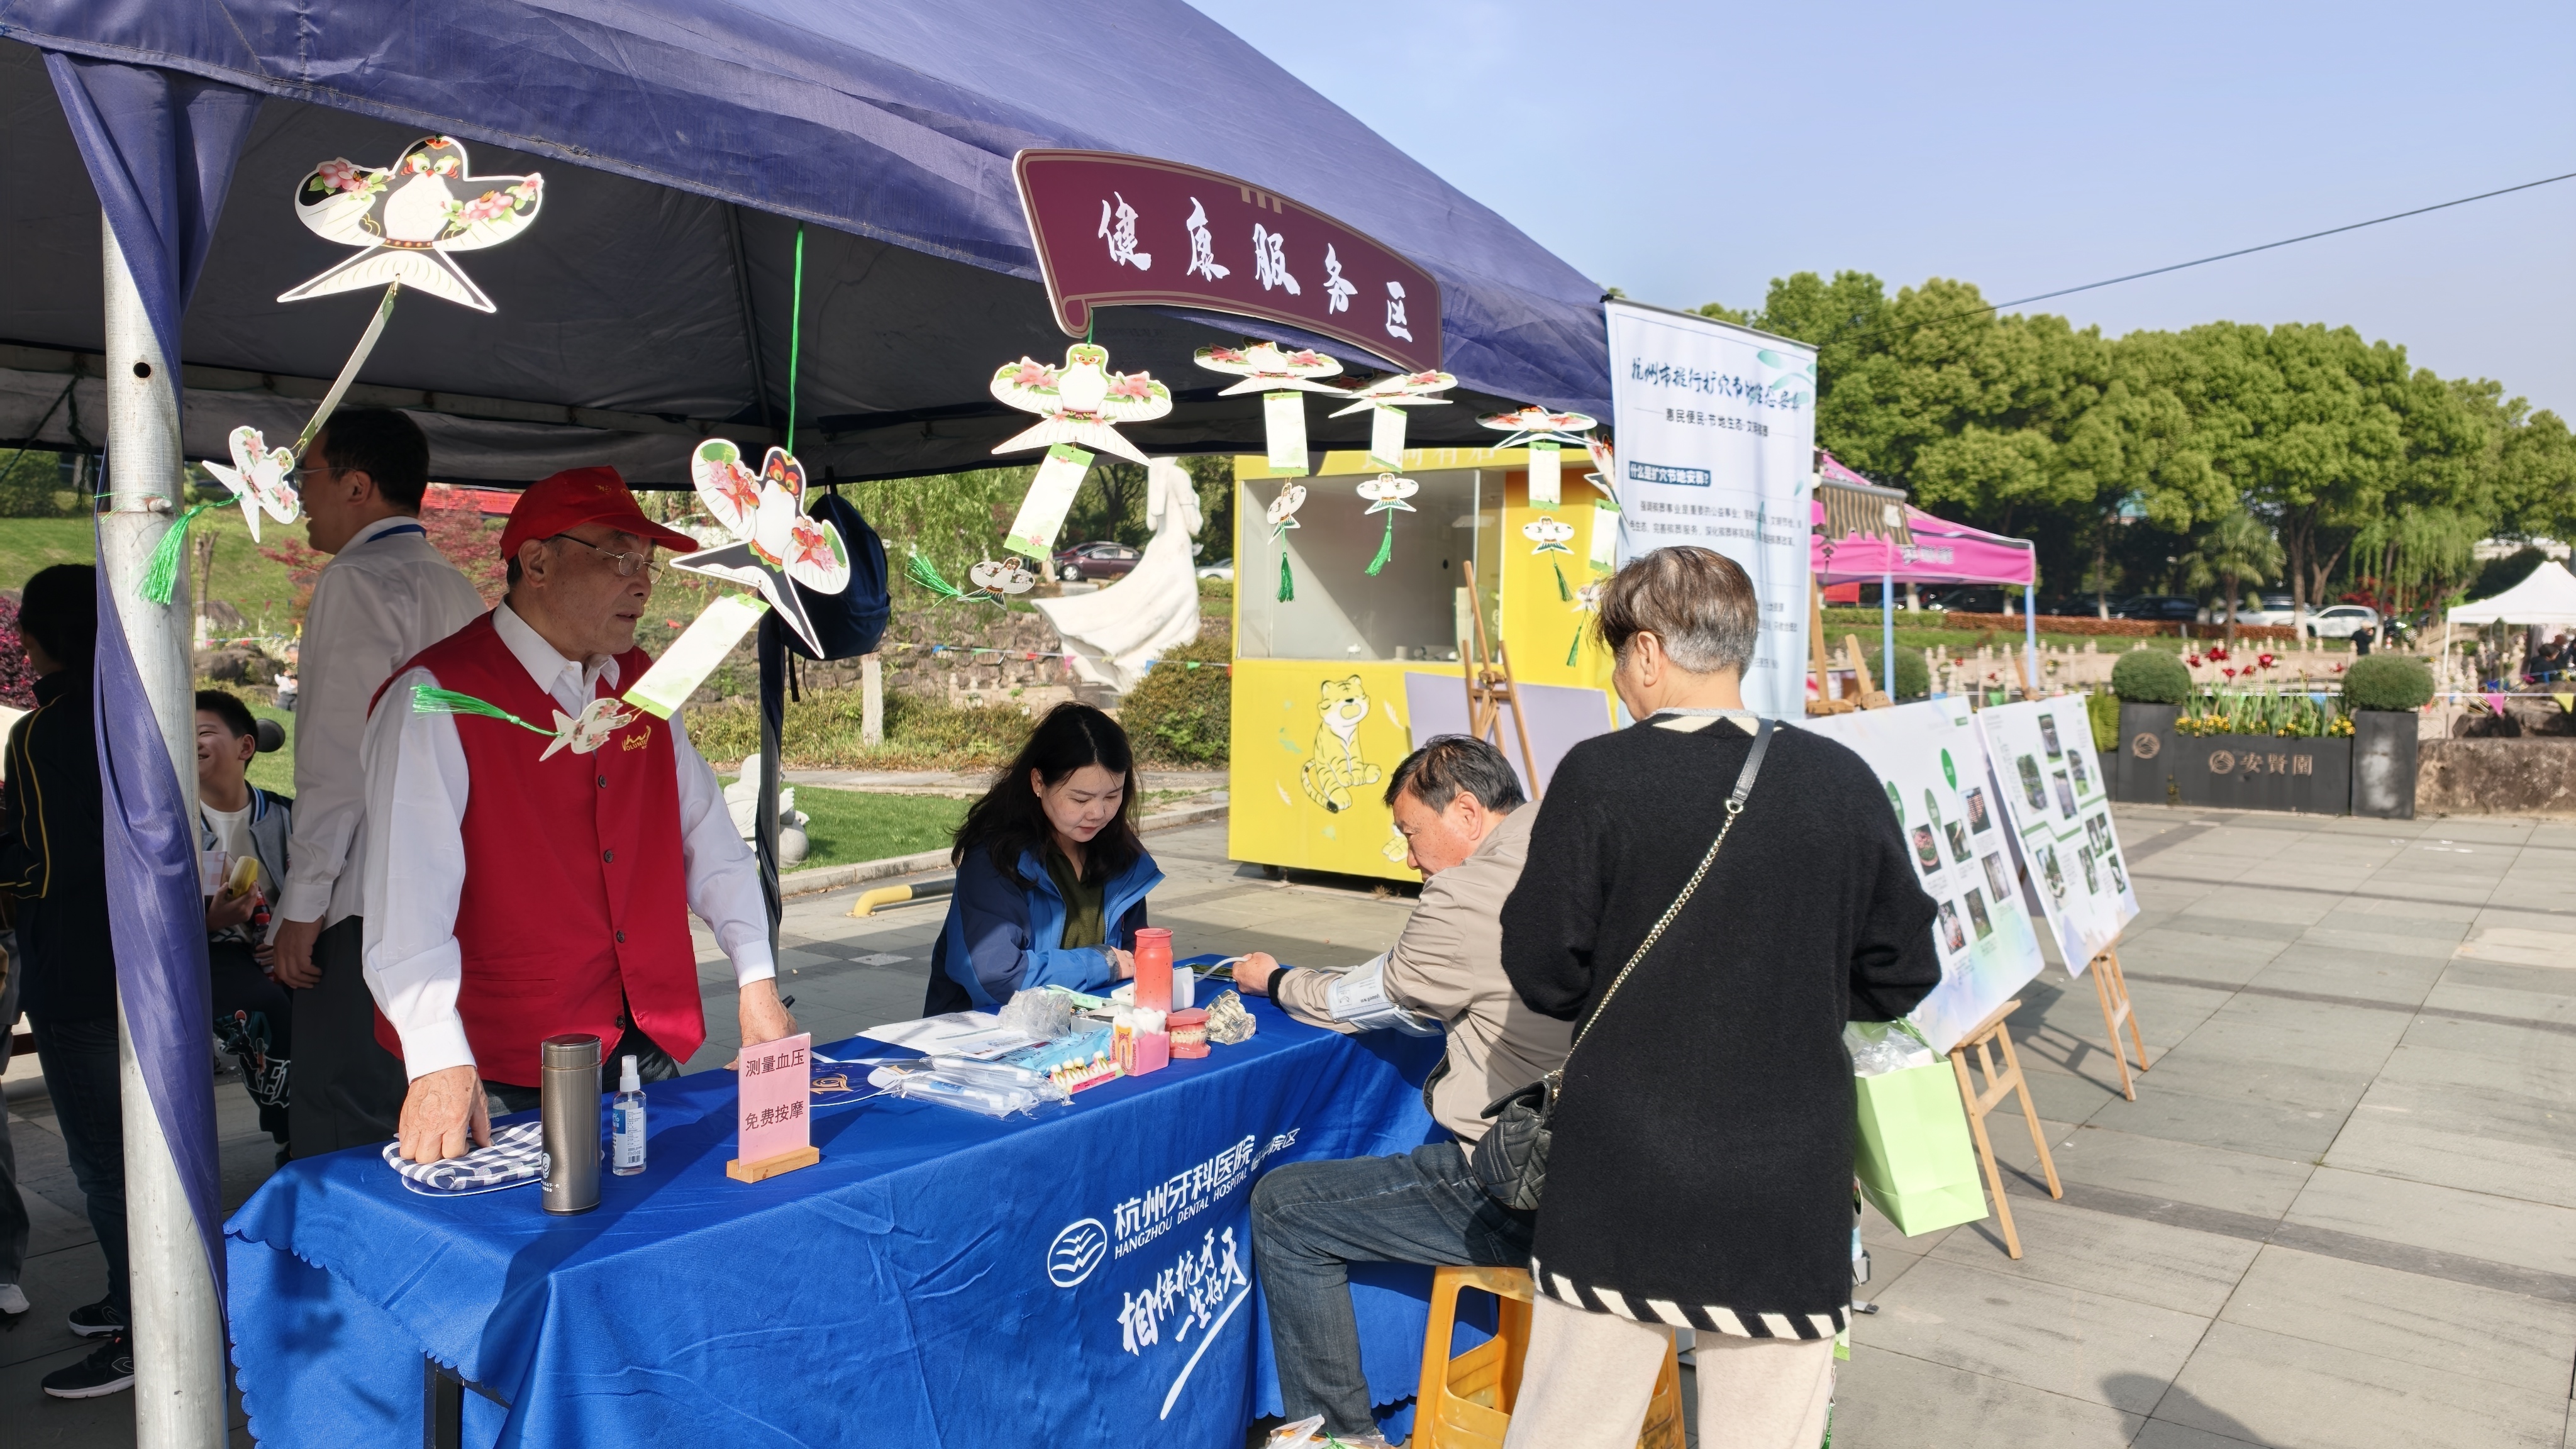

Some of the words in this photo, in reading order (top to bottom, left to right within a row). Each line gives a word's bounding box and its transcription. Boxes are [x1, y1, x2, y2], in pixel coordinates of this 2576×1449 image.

[1097, 191, 1413, 343] 健康服务区
[745, 1048, 804, 1077] 测量血压
[745, 1101, 804, 1131] 免费按摩
[1113, 1135, 1255, 1241] 杭州牙科医院
[1114, 1216, 1172, 1260] HANGZHOU
[1177, 1197, 1209, 1225] DENTAL
[1214, 1167, 1248, 1199] HOSPITAL
